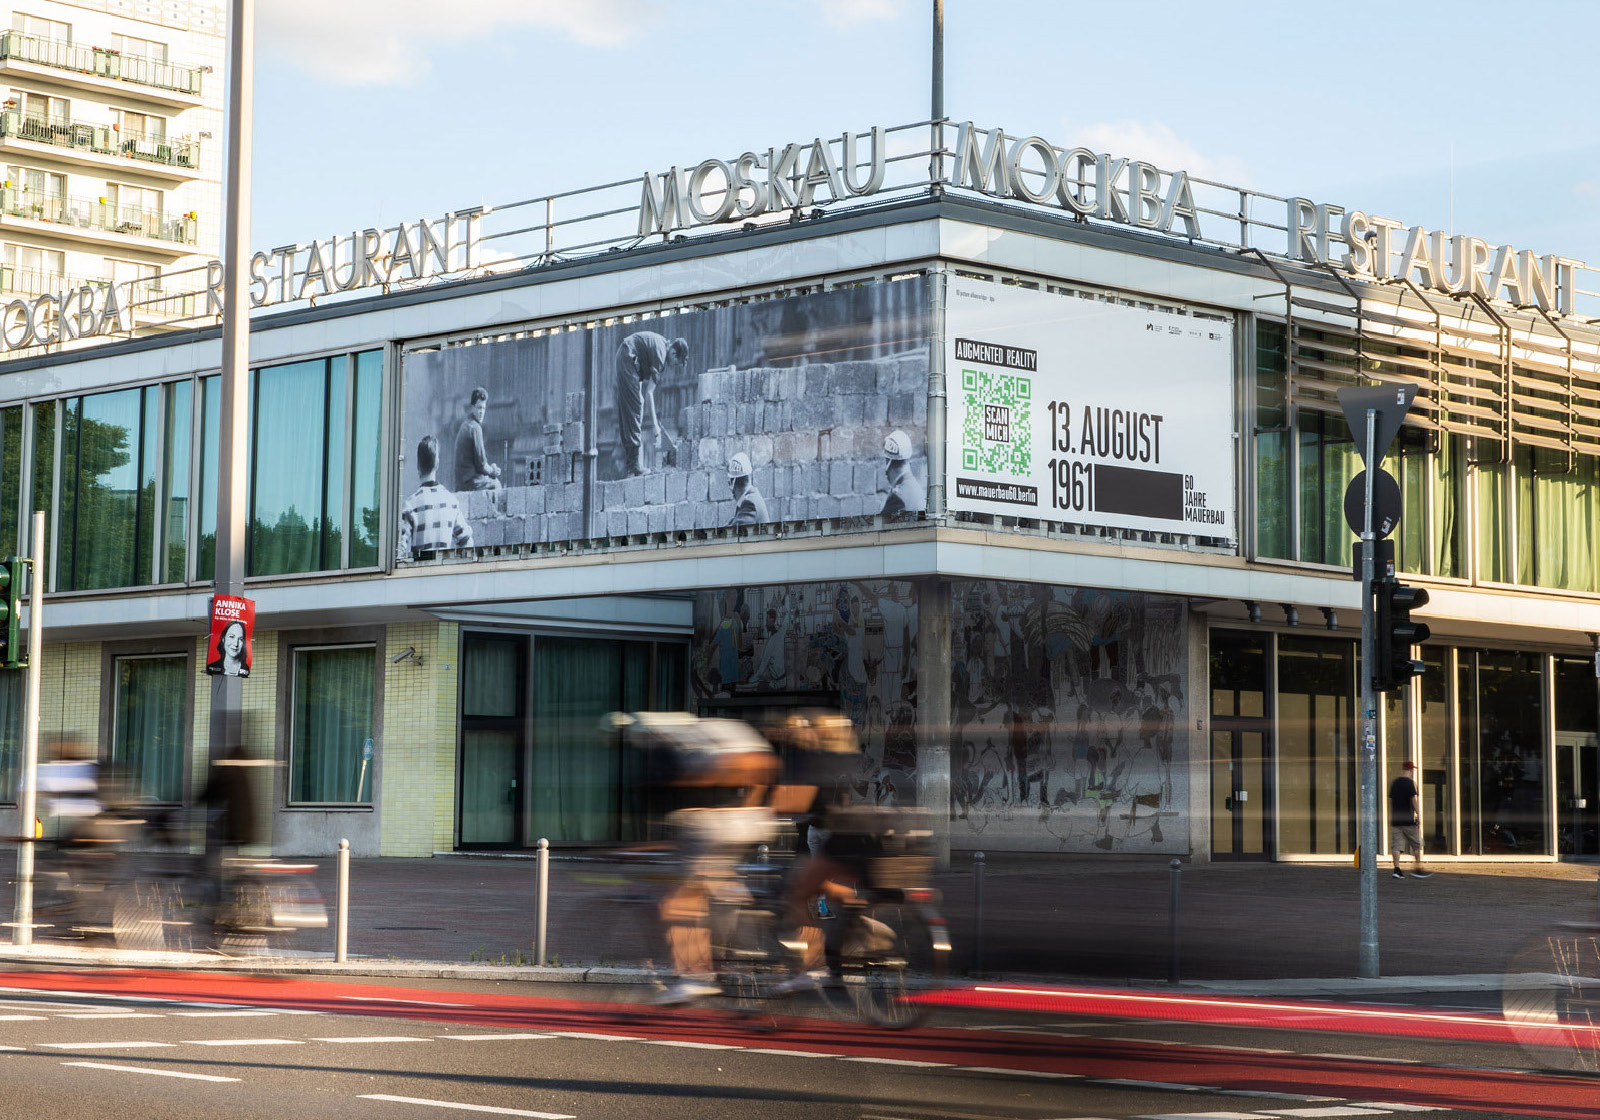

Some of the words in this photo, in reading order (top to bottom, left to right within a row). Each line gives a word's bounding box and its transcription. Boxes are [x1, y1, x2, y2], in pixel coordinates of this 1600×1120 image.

[637, 126, 886, 238] MOSKAU
[206, 205, 491, 317] RSTAURANT
[1287, 197, 1586, 316] RESTAURANT
[0, 280, 130, 352] ОСКВА
[957, 341, 1004, 364] AUGMENTED
[1006, 349, 1036, 369] REALITY
[986, 406, 1008, 425] SCAN
[986, 423, 1008, 442] MICH
[1047, 400, 1076, 454] 13.
[1080, 405, 1163, 464] AUGUST
[1047, 458, 1093, 512] 1961
[1184, 474, 1194, 490] 60
[958, 483, 1036, 503] www.mauerbau60.berlin
[1184, 490, 1207, 508] JAHRE
[1184, 507, 1225, 525] MAUERBAU
[214, 607, 241, 617] KLOSE
[215, 599, 247, 611] ANNIKA
